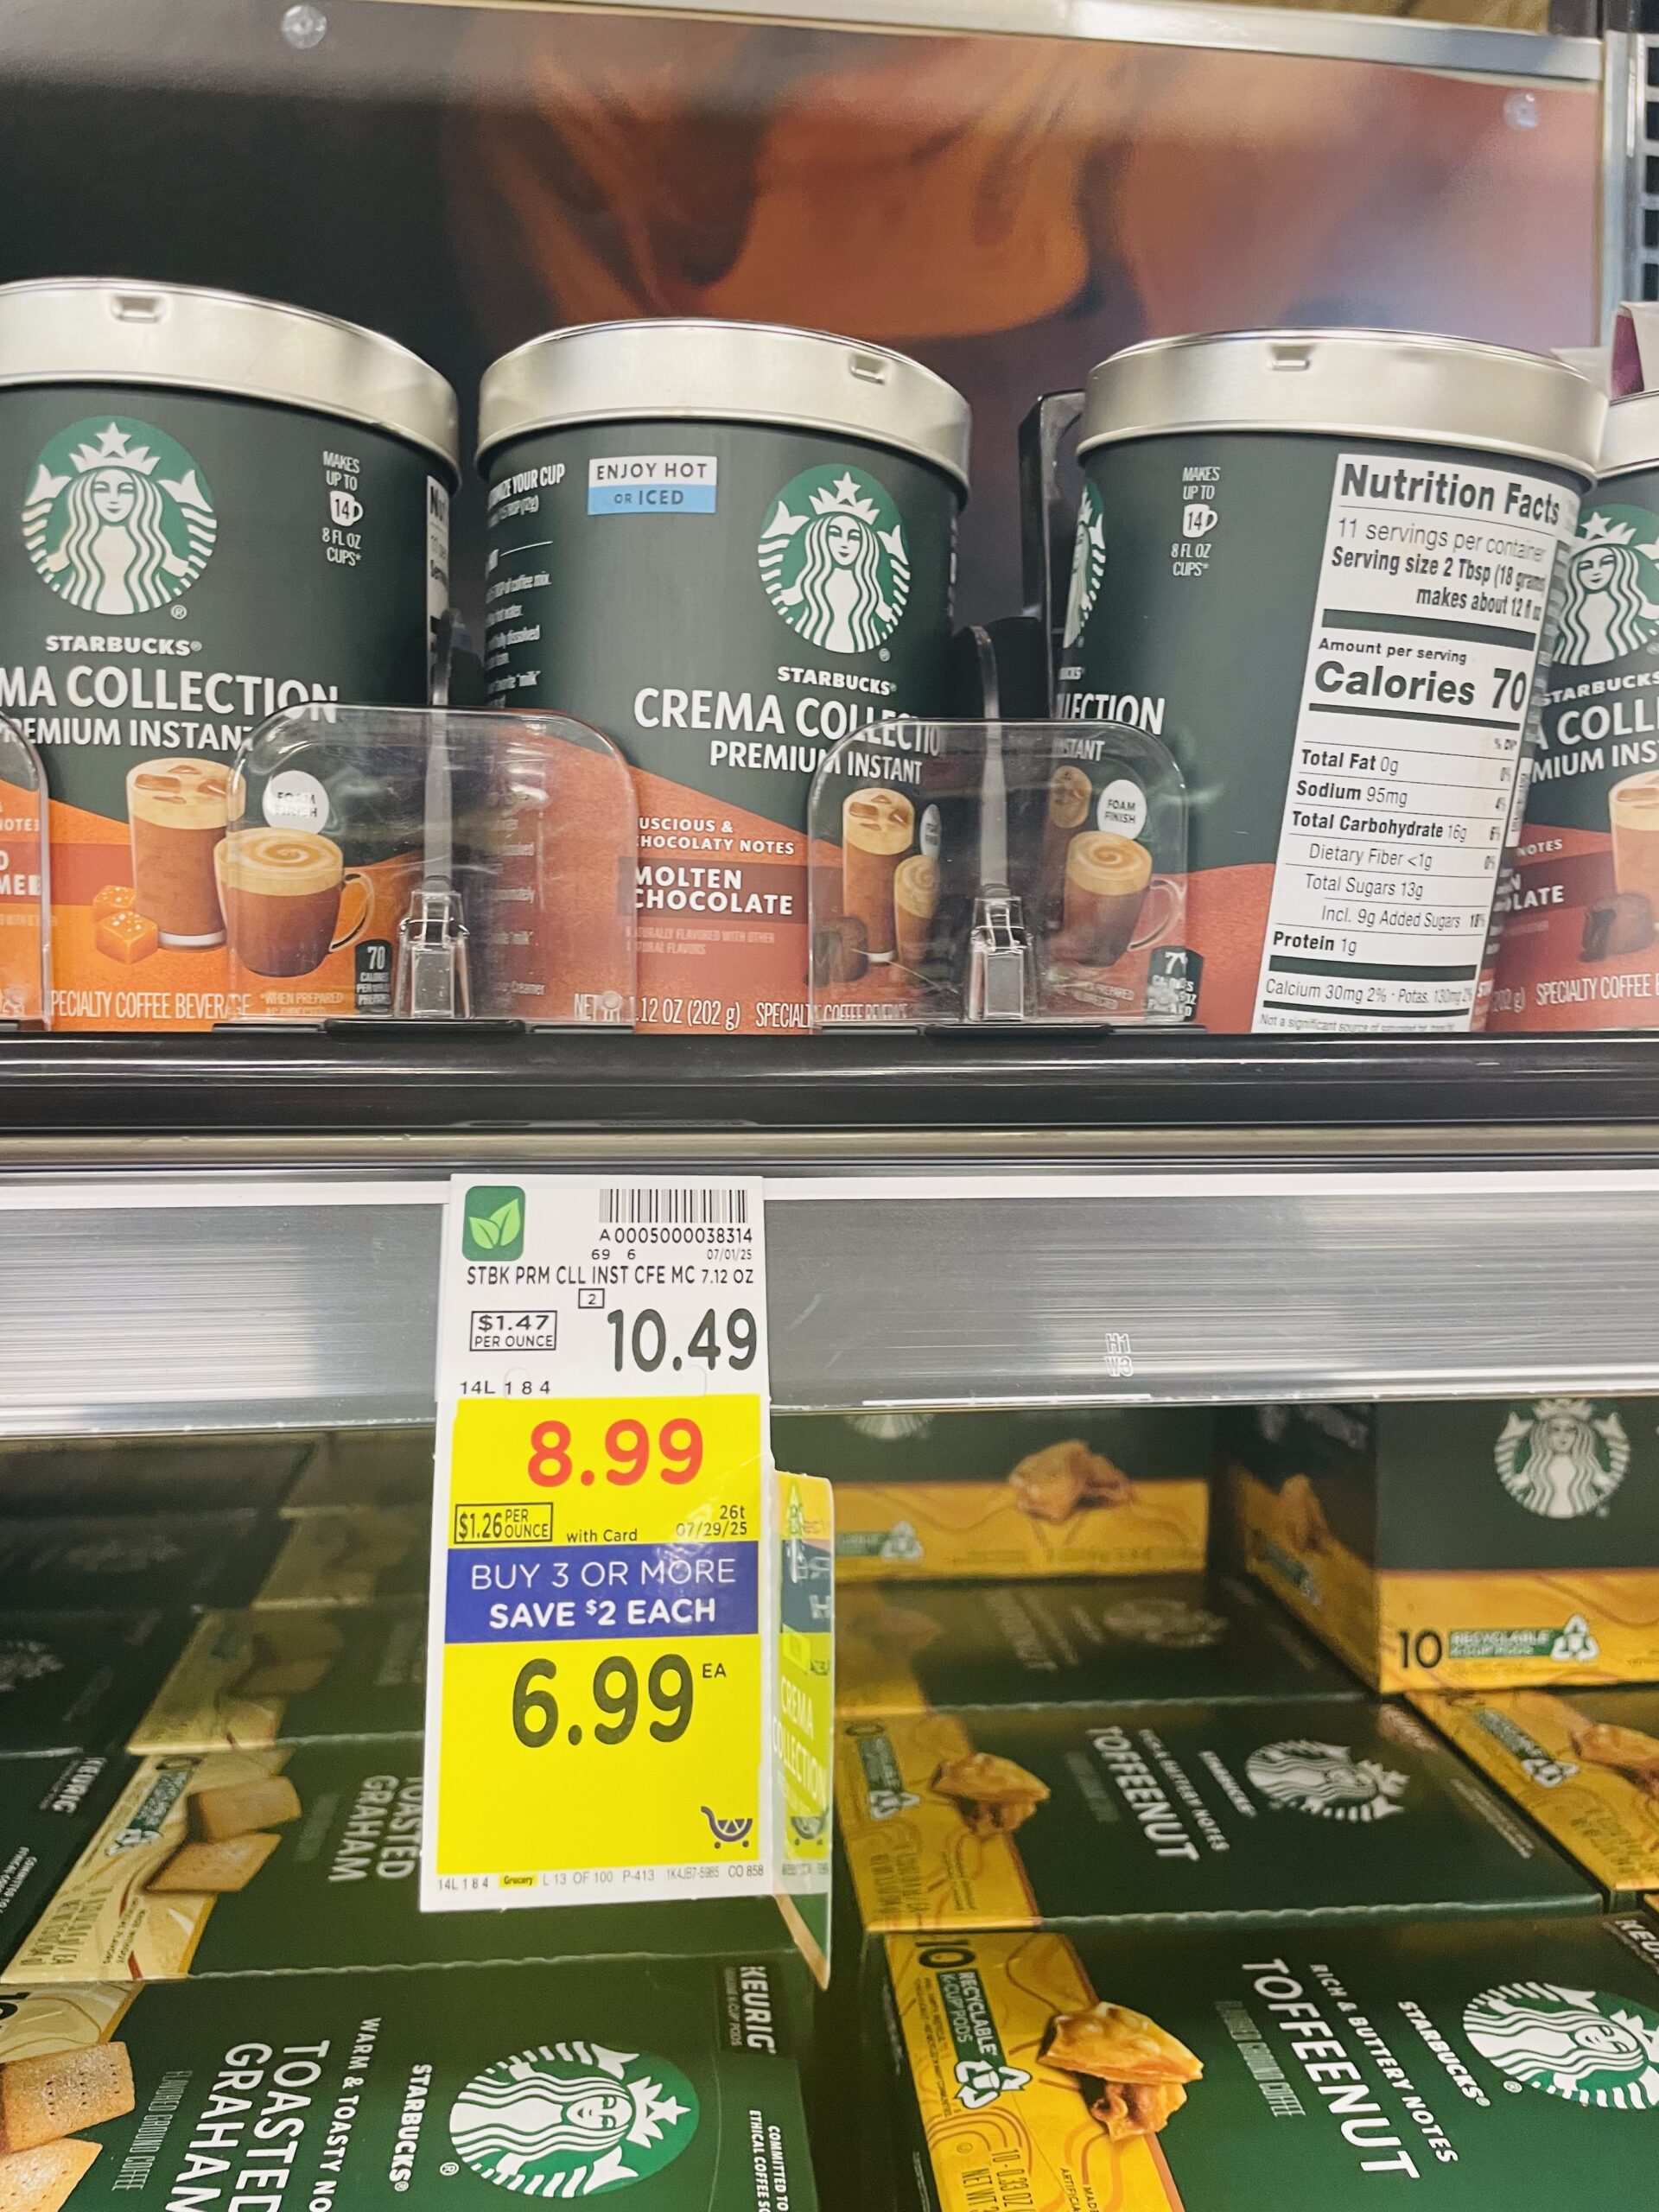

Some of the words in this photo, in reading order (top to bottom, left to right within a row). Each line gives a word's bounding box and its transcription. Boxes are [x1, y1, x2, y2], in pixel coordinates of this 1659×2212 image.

[323, 451, 359, 474] MAKES
[596, 462, 658, 480] ENJOY
[664, 462, 708, 479] HOT
[1183, 467, 1220, 481] MAKES
[326, 470, 342, 486] UP
[343, 474, 358, 491] TO
[512, 469, 537, 494] YOUR
[540, 463, 565, 486] CUP
[614, 493, 632, 505] OR
[639, 490, 684, 505] ICED
[1183, 486, 1198, 499] UP
[1199, 486, 1215, 499] TO
[1341, 463, 1494, 512] Nutrition
[1504, 482, 1560, 525] Facts
[335, 499, 350, 519] 14
[1188, 512, 1202, 531] 14
[322, 527, 331, 543] 8
[332, 530, 346, 546] FL
[346, 533, 361, 550] OZ
[1339, 518, 1357, 538] 11
[1365, 523, 1448, 550] servings
[1453, 533, 1483, 553] per
[1171, 543, 1179, 558] 8
[1180, 544, 1195, 558] FL
[1195, 543, 1211, 558] OZ
[1332, 545, 1400, 575] Serving
[1405, 553, 1438, 575] size
[1443, 557, 1452, 577] 2
[1459, 558, 1491, 588] Tbsp
[1494, 563, 1513, 588] (18
[1416, 587, 1467, 608] makes
[1471, 591, 1508, 614] about
[1511, 597, 1523, 618] 12
[1319, 638, 1381, 655] Amount
[1387, 647, 1412, 658] per
[1417, 650, 1466, 665] serving
[67, 665, 338, 724] COLLECTION
[1315, 660, 1475, 705] Calories
[1492, 668, 1527, 712] 70
[634, 688, 785, 734] CREMA
[710, 741, 841, 774] PREMIUM
[848, 751, 923, 785] INSTANT
[1301, 749, 1344, 768] Total
[1350, 753, 1376, 771] Fat
[1380, 756, 1399, 776] 0g
[1108, 799, 1135, 810] FOAM
[1296, 780, 1361, 801] Sodium
[1367, 786, 1408, 808] 95mg
[721, 820, 734, 834] &
[1105, 811, 1135, 823] FINISH
[1293, 810, 1334, 830] Total
[1339, 815, 1443, 838] Carbohydrate
[1447, 823, 1467, 842] 16g
[740, 840, 794, 855] NOTES
[1309, 843, 1362, 867] Dietary
[1368, 849, 1404, 866] Fiber
[1408, 854, 1433, 871] <1g
[636, 865, 742, 890] MOLTEN
[1306, 874, 1340, 892] Total
[1345, 878, 1395, 899] Sugars
[1401, 881, 1423, 899] 13g
[1321, 906, 1351, 923] Incl.
[1358, 908, 1376, 927] 9g
[1379, 911, 1420, 927] Added
[1424, 913, 1460, 931] Sugars
[1273, 931, 1334, 951] Protein
[1341, 938, 1357, 956] 1g
[367, 946, 385, 969] 70
[1266, 978, 1321, 999] Calcium
[1325, 985, 1363, 1004] 30mg
[1367, 988, 1387, 1003] 2%
[1397, 988, 1429, 1003] Potas.
[1536, 977, 1599, 1006] SPECIALTY
[1601, 974, 1652, 999] COFFEE
[116, 992, 171, 1019] COFFEE
[663, 999, 683, 1024] OZ
[688, 1000, 721, 1027] (202
[726, 1002, 741, 1031] g)
[1261, 1014, 1277, 1026] Not
[1280, 1018, 1286, 1027] a
[1288, 1019, 1337, 1032] significant
[591, 1249, 610, 1260] 69
[627, 1249, 636, 1260] 6
[707, 1249, 752, 1261] 07/01/25
[467, 1266, 510, 1285] STBK
[516, 1266, 550, 1284] PRM
[556, 1266, 586, 1284] CLL
[592, 1266, 629, 1284] INST
[635, 1267, 665, 1284] CFE
[672, 1267, 695, 1284] MC
[702, 1269, 728, 1284] 7.12
[734, 1269, 753, 1284] OZ
[588, 1294, 596, 1305] 2
[479, 1314, 550, 1332] $1.47
[474, 1335, 502, 1348] PER
[505, 1335, 554, 1348] OUNCE
[607, 1308, 757, 1372] 10.49
[461, 1382, 495, 1395] 14L
[527, 1417, 703, 1487] 8.99
[458, 1511, 502, 1541] $1.26
[505, 1523, 549, 1539] OUNCE
[567, 1529, 598, 1542] with
[603, 1529, 638, 1542] Card
[677, 1522, 747, 1538] 07/29/25
[505, 1509, 529, 1523] PER
[720, 1505, 745, 1520] 26t
[472, 1563, 541, 1590] BUY
[552, 1563, 569, 1587] 3
[582, 1561, 629, 1586] OR
[641, 1559, 735, 1585] MORE
[489, 1602, 575, 1630] SAVE
[586, 1599, 617, 1626] $2
[628, 1599, 715, 1624] EACH
[1397, 1628, 1443, 1669] 10
[512, 1653, 694, 1748] 6.99
[702, 1662, 727, 1679] EA
[780, 1675, 814, 1741] CREMA
[328, 1775, 400, 1882] GRAHAM
[438, 1878, 458, 1891] 14L
[503, 1875, 534, 1886] Grocery
[543, 1874, 550, 1886] L
[555, 1873, 567, 1885] 13
[573, 1872, 589, 1885] OF
[594, 1871, 613, 1884] 100
[623, 1870, 655, 1883] P-413
[728, 1865, 744, 1878] CO
[747, 1864, 764, 1877] 858
[914, 1939, 976, 1968] 10
[958, 1971, 998, 2056] RECYCLABLE
[347, 2017, 382, 2070] WARM
[1242, 1958, 1421, 2178] TOFFEENUT
[1310, 1963, 1346, 1998] RICH
[1338, 2002, 1357, 2012] &
[1348, 2017, 1414, 2090] BUTTERY
[1402, 2096, 1459, 2163] NOTES
[342, 2076, 364, 2089] &
[130, 2114, 173, 2153] GROUND
[165, 2043, 273, 2212] GRAHAM
[228, 2039, 330, 2212] TOASTED
[319, 2094, 360, 2172] TOASTY
[749, 2110, 766, 2154] ETHICAL
[767, 2126, 787, 2194] COMMITTED
[777, 2196, 790, 2212] TO
[992, 2149, 1020, 2162] 10
[111, 2156, 156, 2191] COFFEE
[754, 2157, 770, 2198] COFFEE
[962, 2168, 993, 2188] NET
[996, 2168, 1029, 2191] 0.33
[966, 2188, 997, 2206] WT
[1002, 2192, 1033, 2207] OZ
